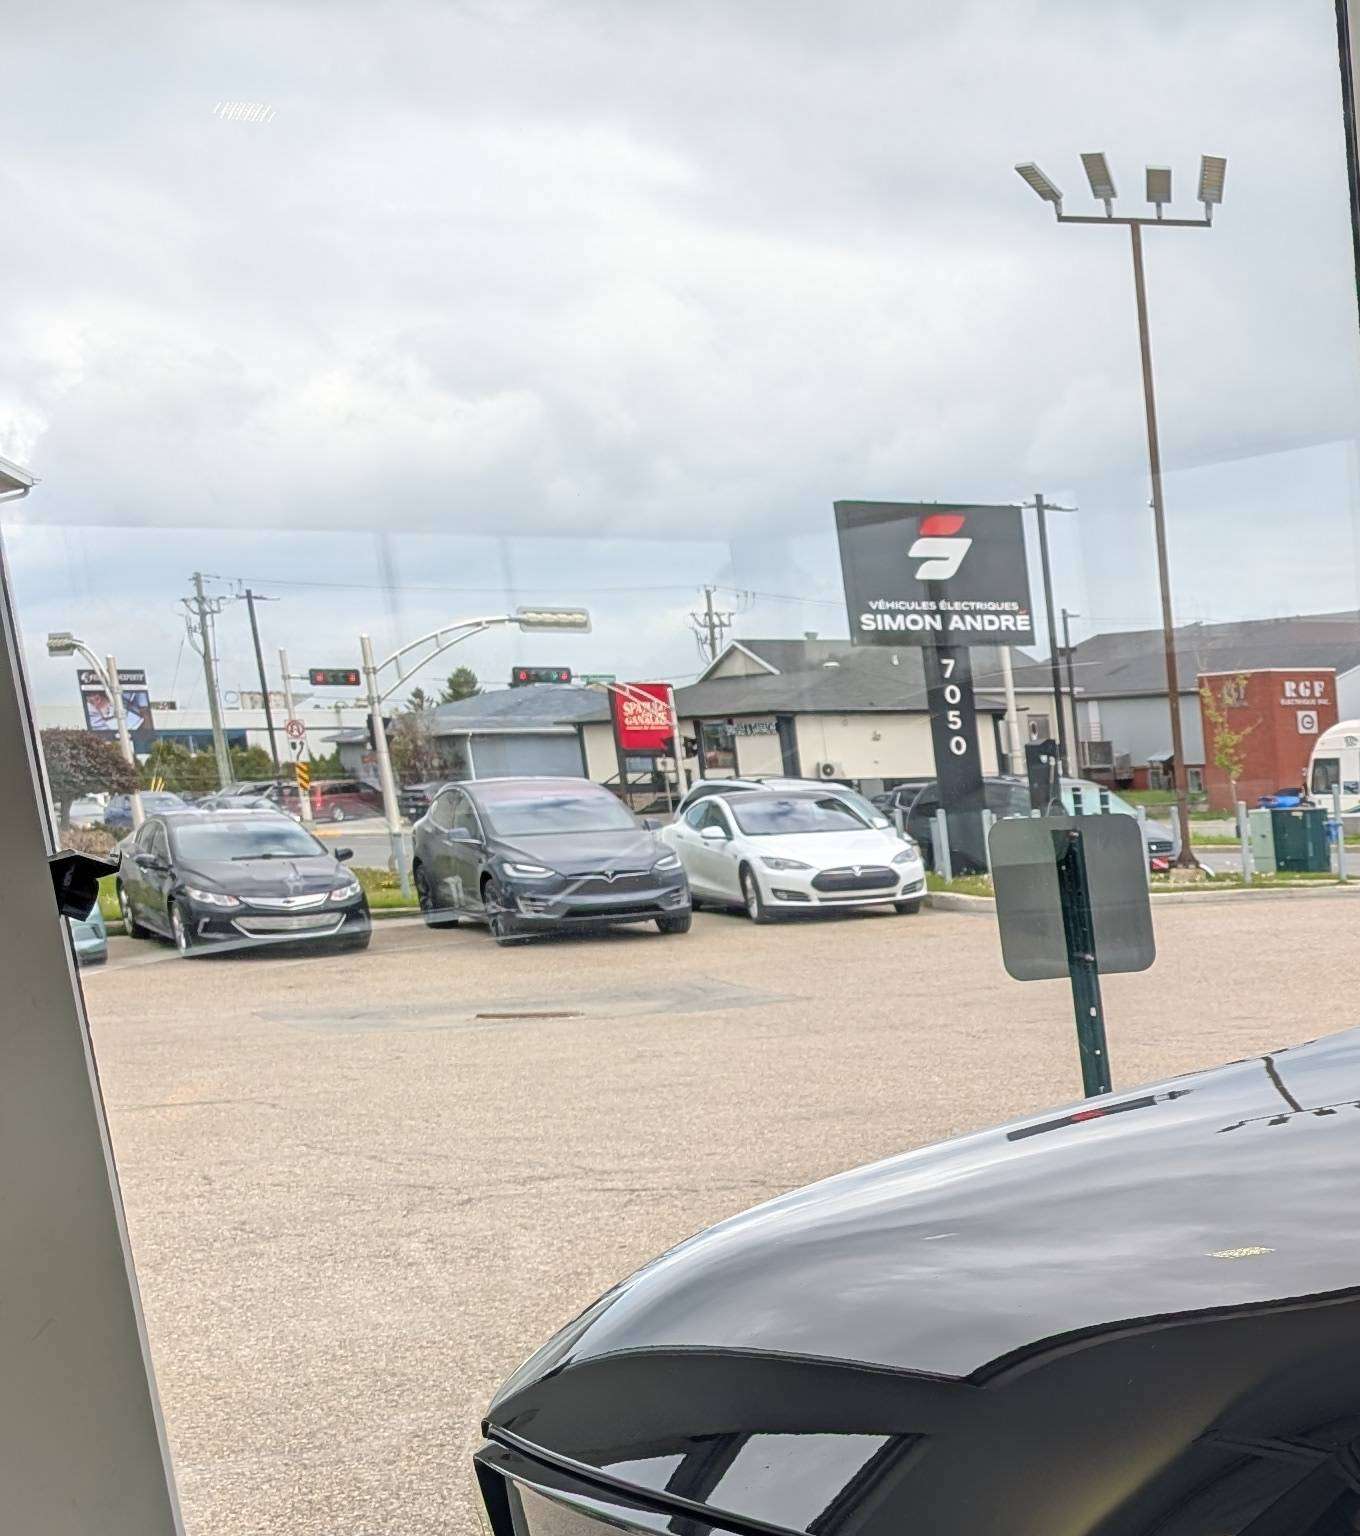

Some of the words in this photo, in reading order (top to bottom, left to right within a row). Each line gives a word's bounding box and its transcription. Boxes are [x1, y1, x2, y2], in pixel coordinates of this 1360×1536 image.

[868, 598, 937, 611] VÉHICULES
[939, 598, 1019, 611] ÉLECTRIQUES
[860, 613, 943, 631] SIMON
[948, 608, 1031, 631] ANDRÉ
[941, 658, 967, 755] 7050
